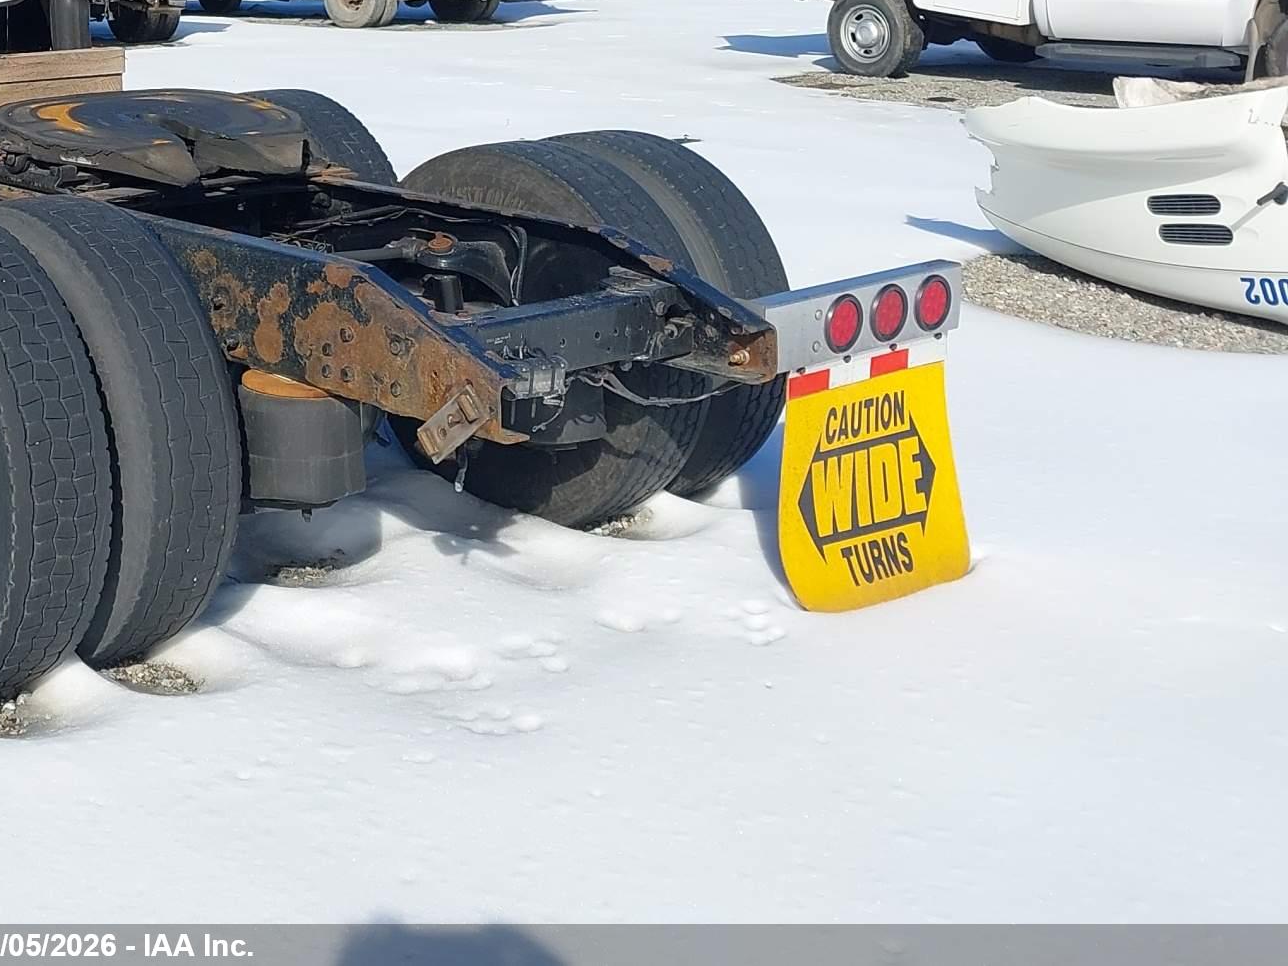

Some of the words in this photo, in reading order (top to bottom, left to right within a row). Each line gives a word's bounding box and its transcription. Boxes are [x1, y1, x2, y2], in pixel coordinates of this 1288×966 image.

[825, 389, 905, 446] CAUTION
[811, 435, 928, 538] WIDE
[840, 531, 914, 587] TURNS
